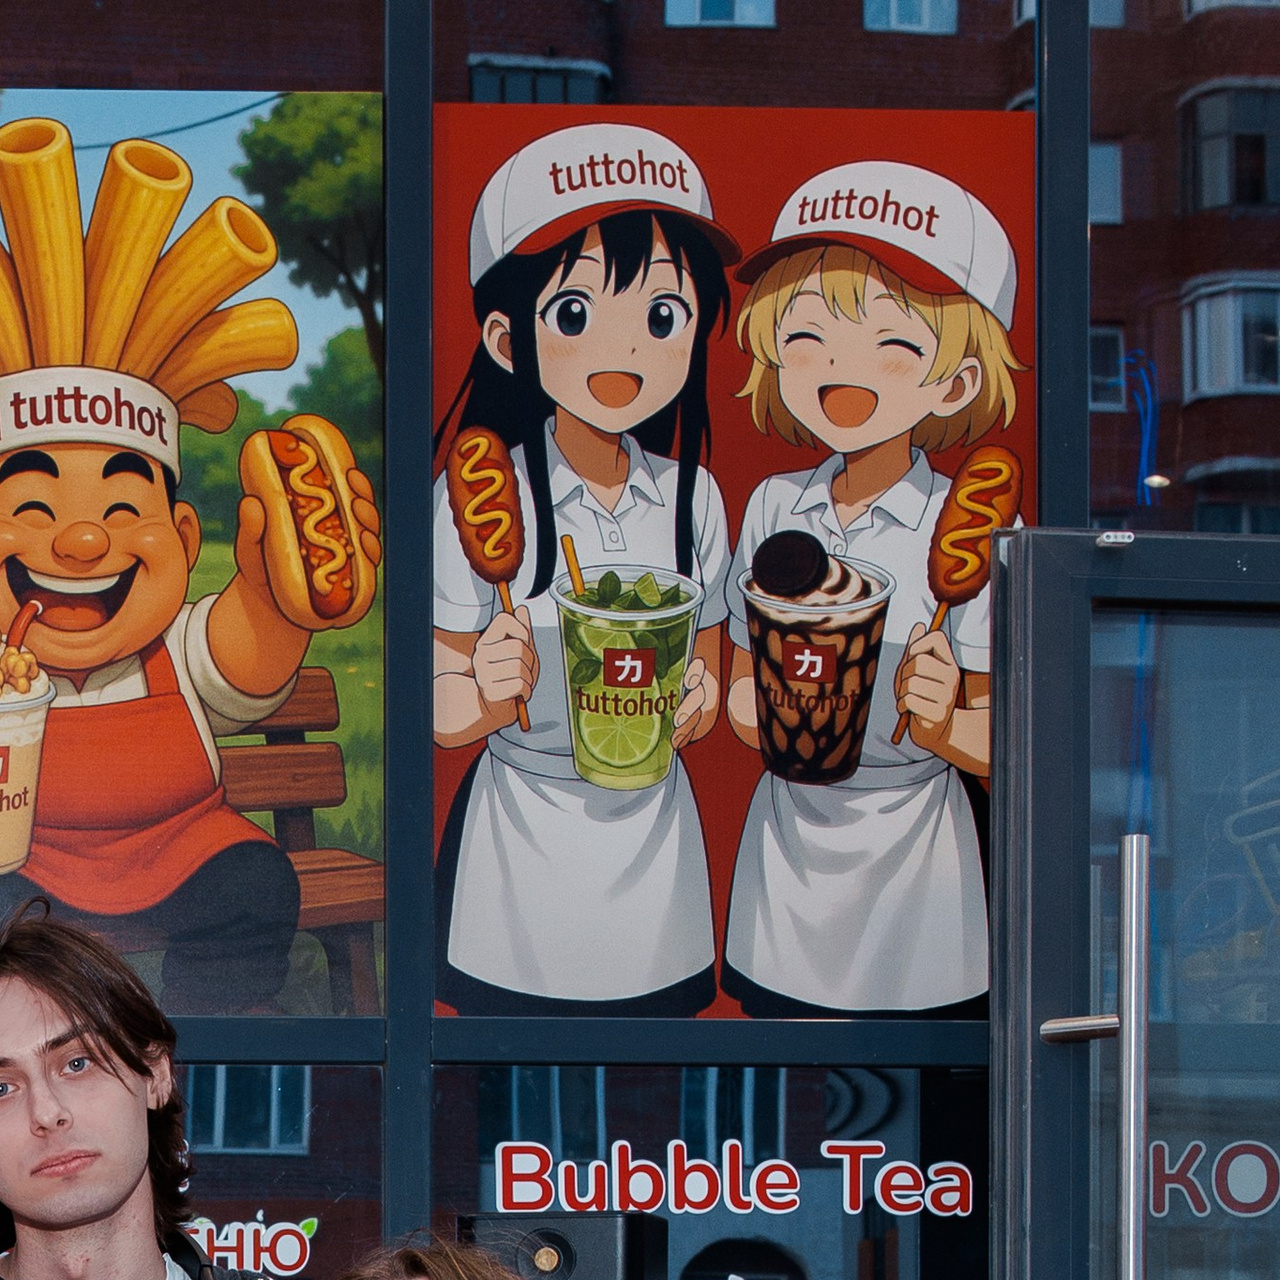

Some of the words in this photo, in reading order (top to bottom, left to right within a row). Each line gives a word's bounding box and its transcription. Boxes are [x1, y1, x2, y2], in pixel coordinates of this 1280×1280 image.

[549, 149, 689, 194] tuttohot
[798, 189, 939, 237] tuttohot
[10, 386, 168, 446] tuttohot
[576, 686, 676, 717] tuttohot
[769, 687, 860, 712] tuttohot
[497, 1140, 799, 1212] Bubble
[823, 1141, 972, 1214] Tea
[187, 1226, 309, 1273] НЮ
